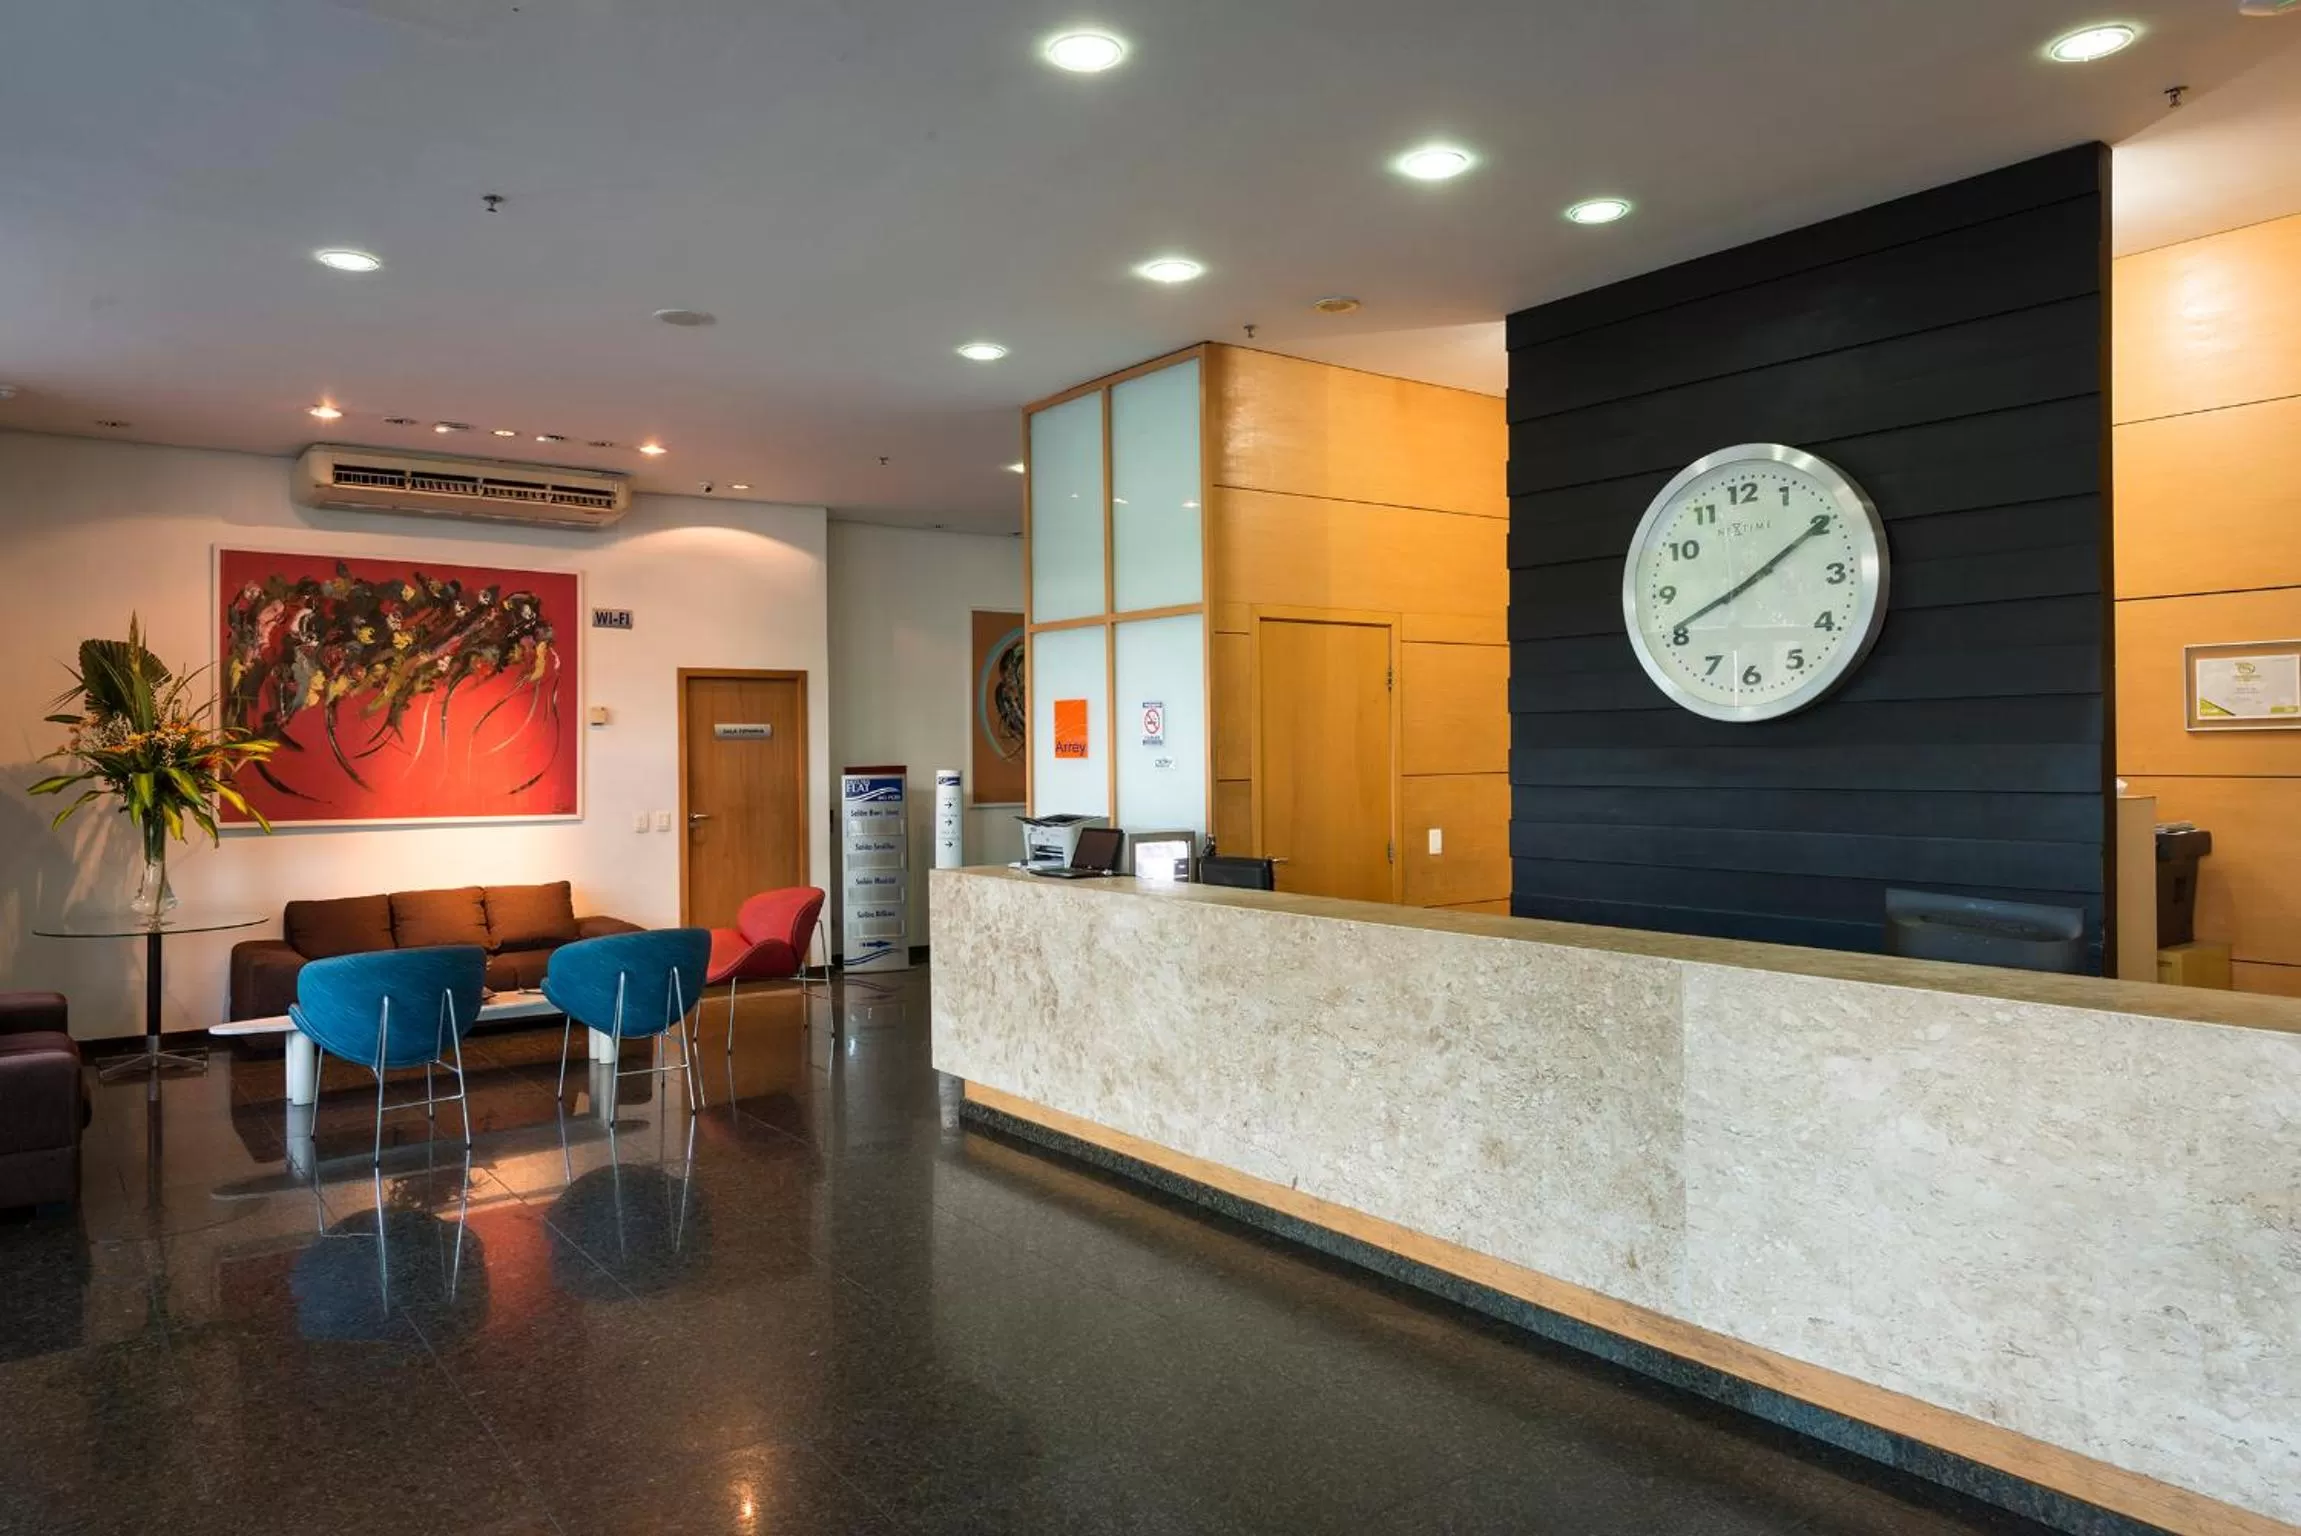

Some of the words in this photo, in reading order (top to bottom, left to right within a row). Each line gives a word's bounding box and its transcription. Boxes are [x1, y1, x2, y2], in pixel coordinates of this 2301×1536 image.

[1727, 483, 1758, 505] 12
[1779, 487, 1790, 506] 1
[1694, 504, 1716, 525] 11
[1810, 515, 1830, 536] 2
[1669, 540, 1699, 561] 10
[1826, 563, 1846, 584] 3
[1659, 586, 1676, 604] 9
[595, 612, 630, 625] WI-FI
[1814, 611, 1834, 631] 4
[1673, 627, 1689, 646] 8
[1705, 655, 1723, 675] 7
[1786, 649, 1804, 670] 5
[1742, 666, 1761, 685] 6
